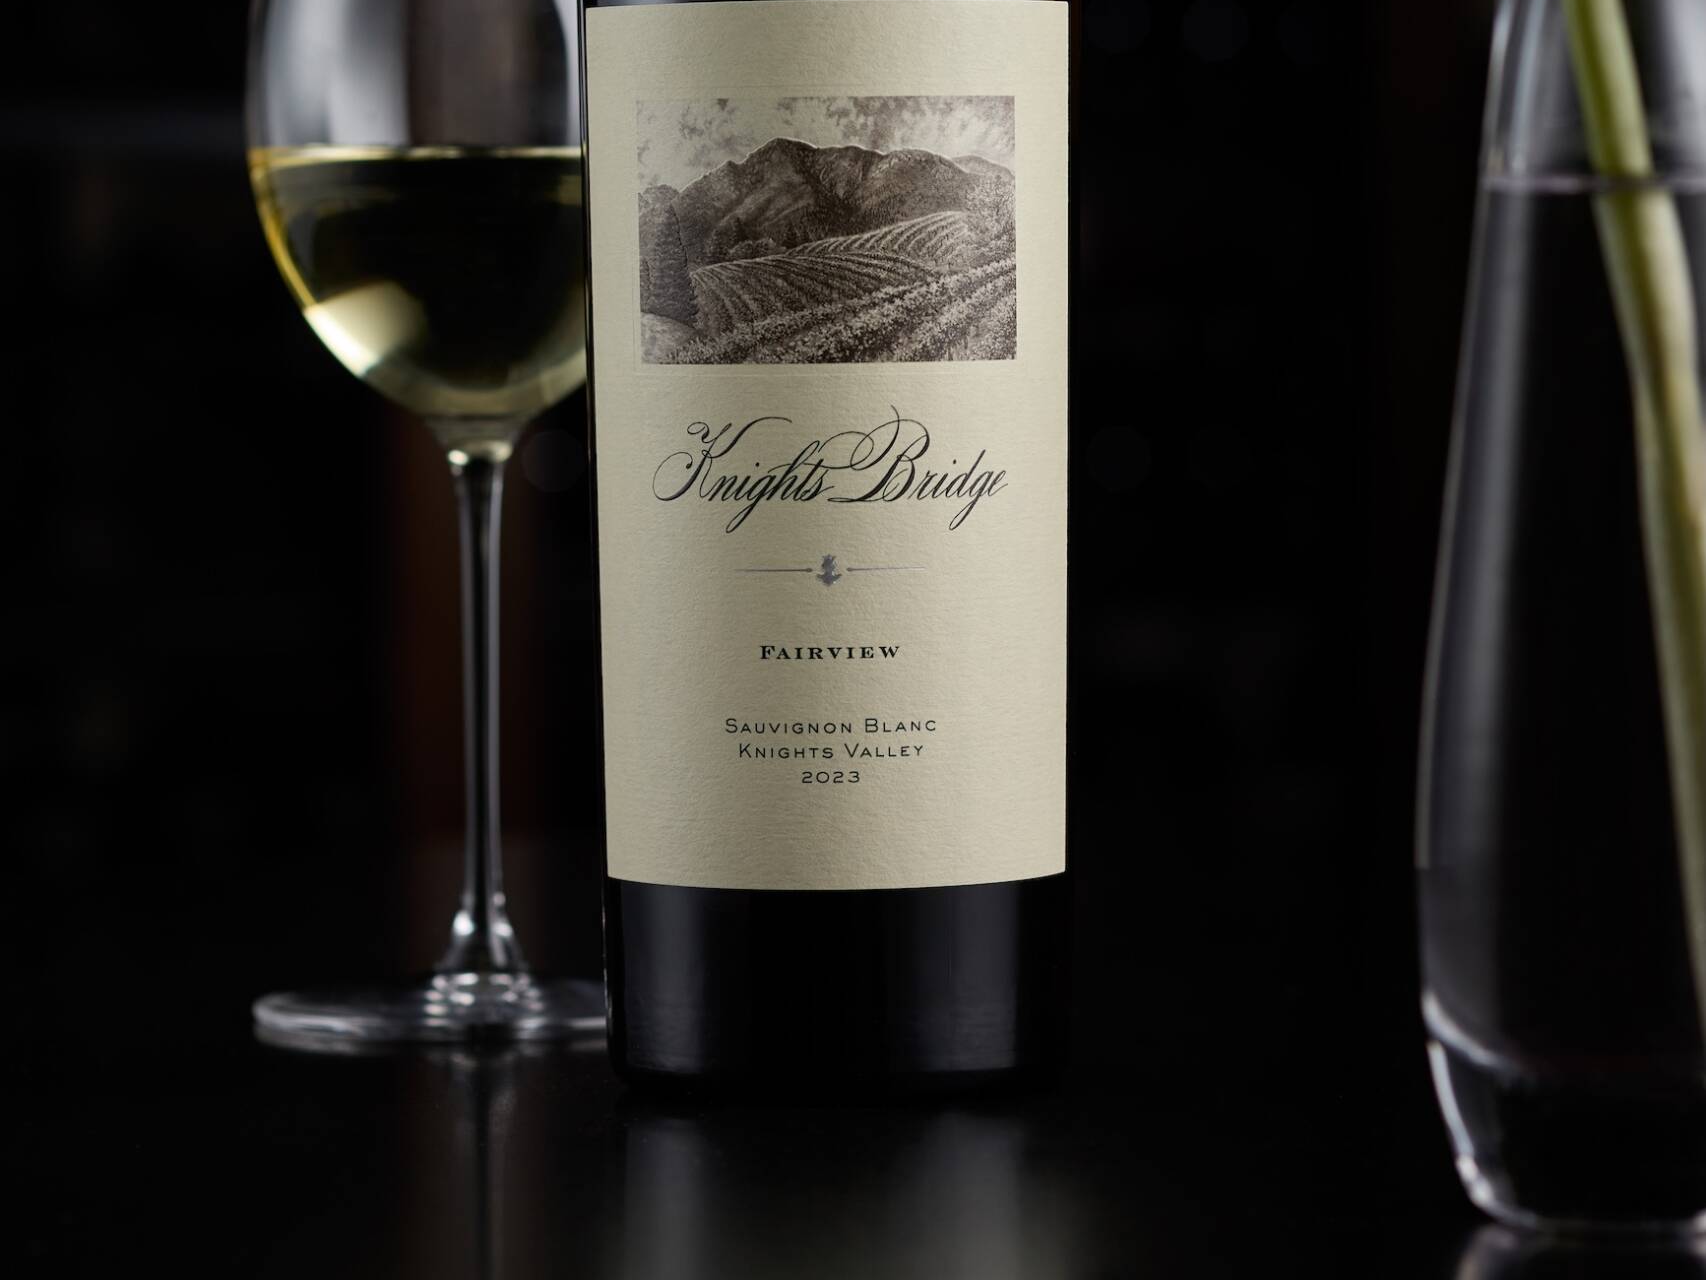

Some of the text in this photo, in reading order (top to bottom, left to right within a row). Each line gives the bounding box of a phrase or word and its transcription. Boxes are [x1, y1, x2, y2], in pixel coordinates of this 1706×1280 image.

[652, 404, 1009, 534] Knights Bridge
[759, 645, 901, 661] FAIRVIEW
[725, 717, 938, 735] SAUVIGNON BLANC
[738, 742, 925, 760] KNIGHTS VALLEY
[800, 770, 862, 785] 2023
